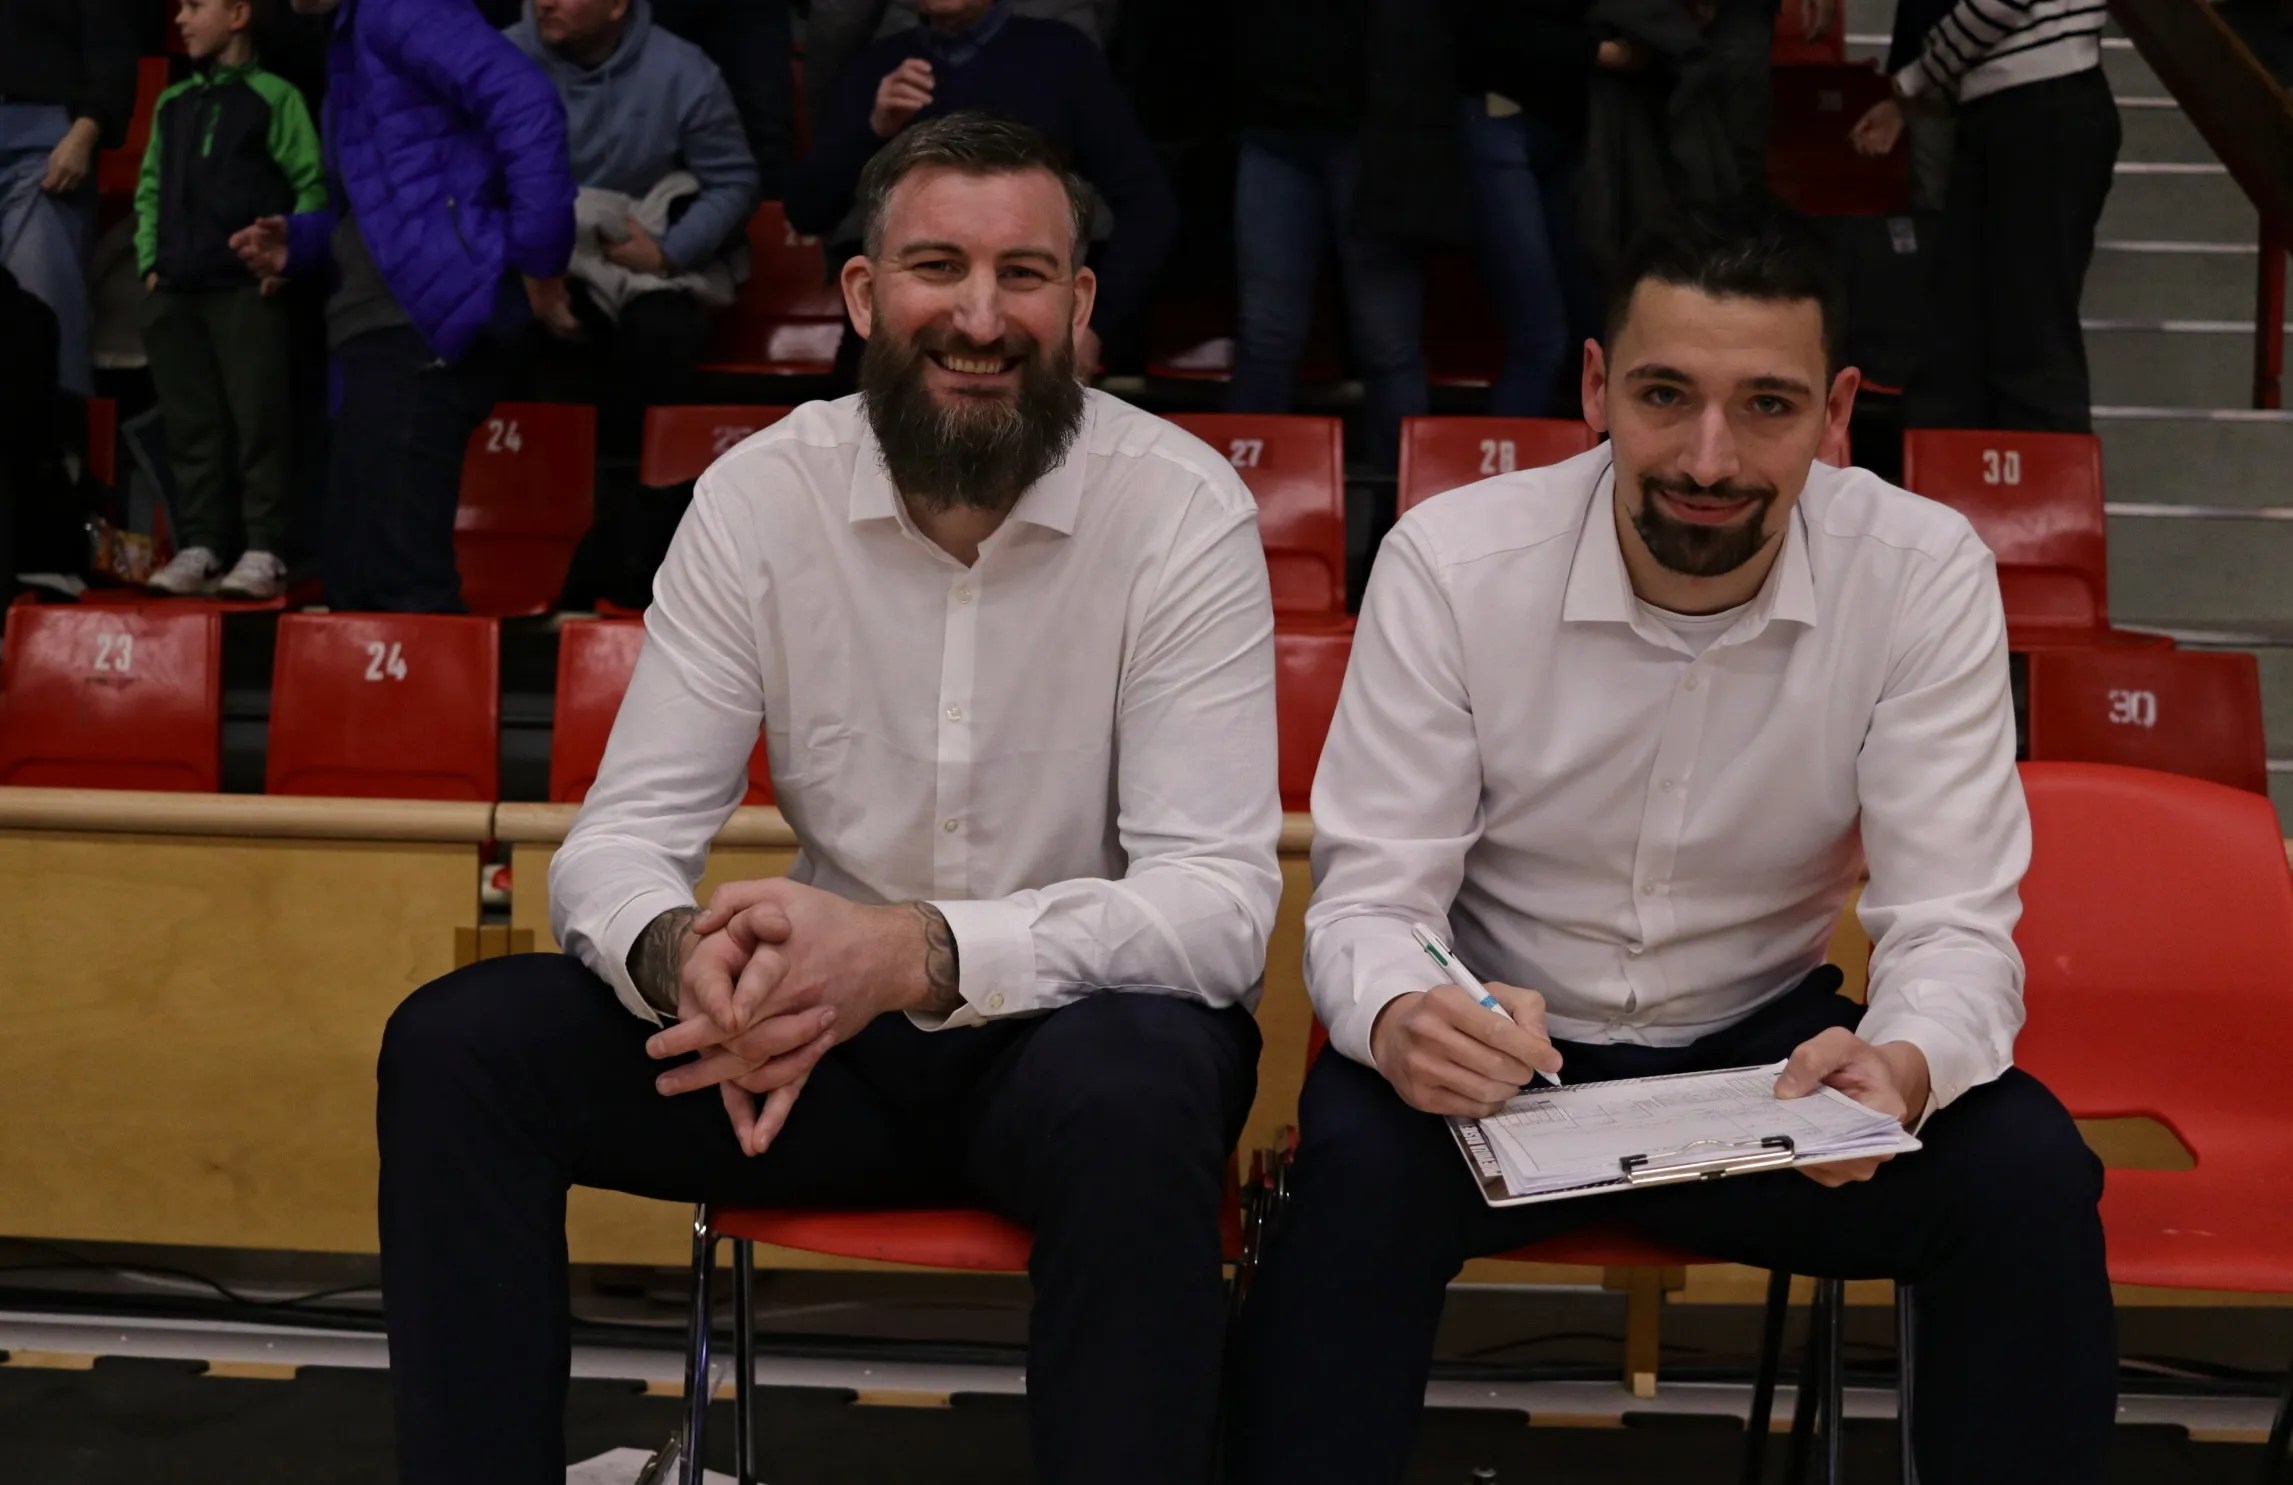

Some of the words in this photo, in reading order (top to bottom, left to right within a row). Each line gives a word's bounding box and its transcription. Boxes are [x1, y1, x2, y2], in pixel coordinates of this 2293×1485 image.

[486, 419, 522, 452] 24
[712, 427, 754, 456] 2
[1229, 439, 1264, 468] 27
[1480, 439, 1516, 474] 28
[1982, 449, 2021, 486] 30
[94, 632, 133, 672] 23
[365, 641, 408, 681] 24
[2108, 690, 2156, 728] 30
